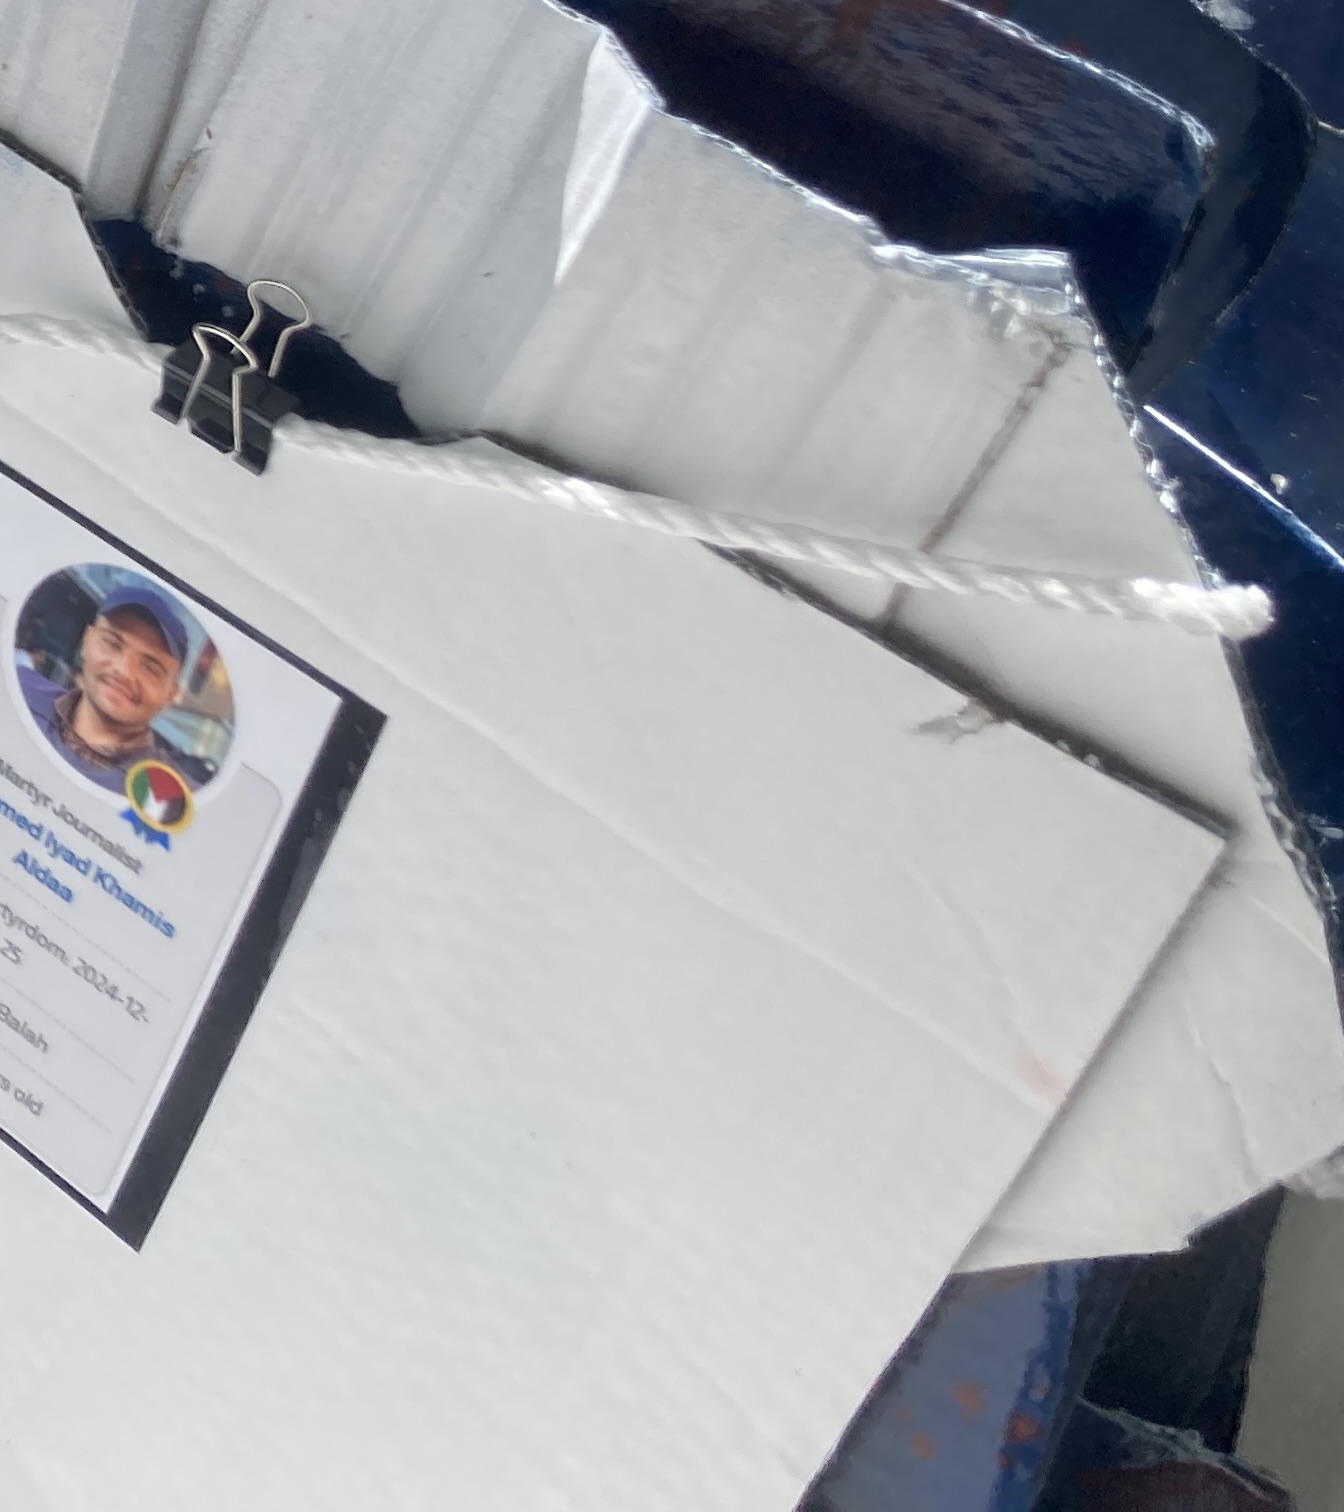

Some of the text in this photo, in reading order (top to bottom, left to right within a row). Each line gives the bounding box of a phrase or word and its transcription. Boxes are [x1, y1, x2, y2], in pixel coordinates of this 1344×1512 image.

[51, 803, 144, 876] Journalist
[43, 830, 92, 876] Iyad
[92, 866, 176, 939] Khamis
[12, 1087, 45, 1117] old
